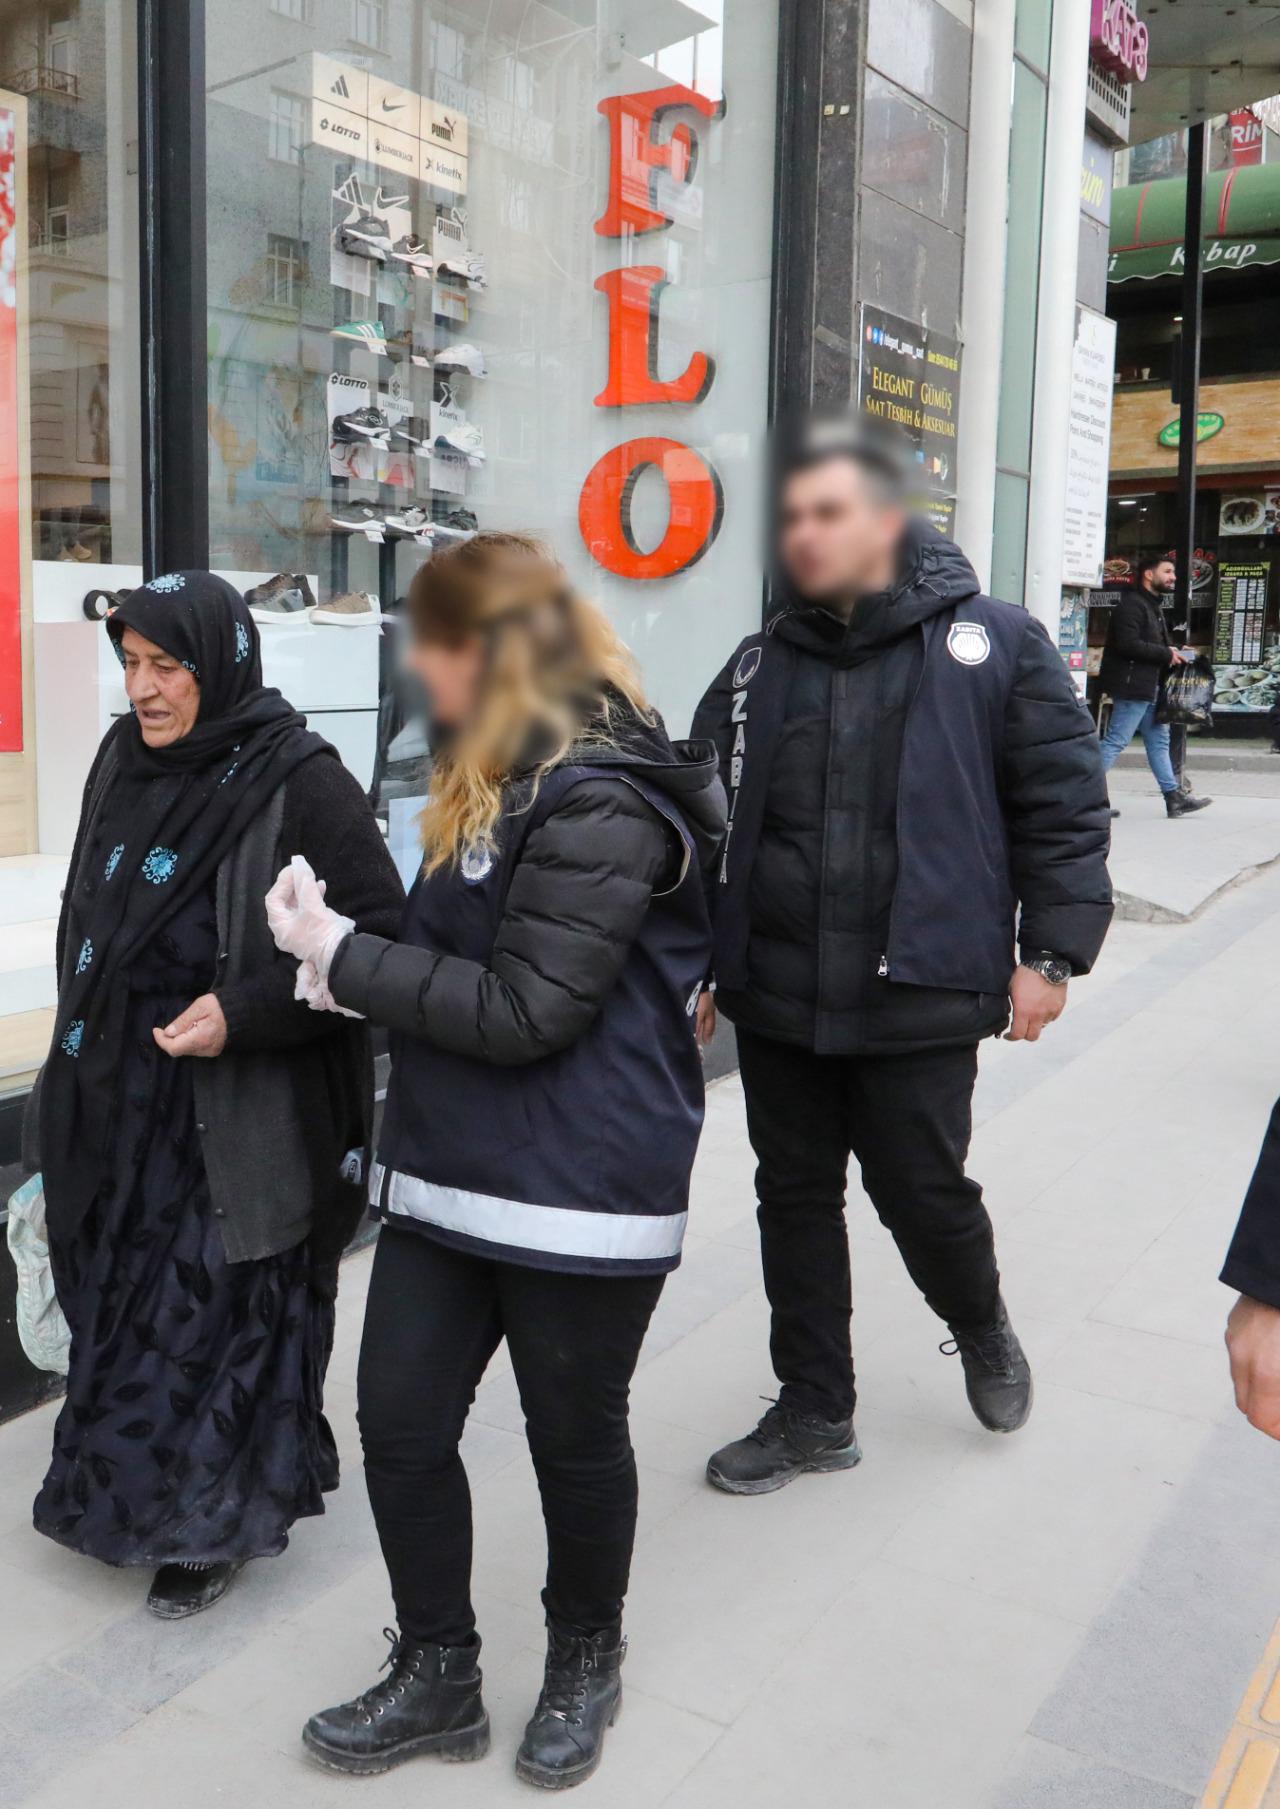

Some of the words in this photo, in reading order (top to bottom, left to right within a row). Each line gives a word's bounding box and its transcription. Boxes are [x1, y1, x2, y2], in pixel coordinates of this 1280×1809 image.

[331, 123, 360, 140] LOTTO
[431, 123, 452, 142] PUMA
[1170, 241, 1257, 267] Kbap
[579, 83, 726, 580] FLO
[338, 376, 368, 390] LOTTO
[873, 366, 915, 399] ELEGANT
[920, 382, 953, 416] GÜMÜŞ
[913, 410, 921, 427] &
[719, 690, 749, 884] ZABITA
